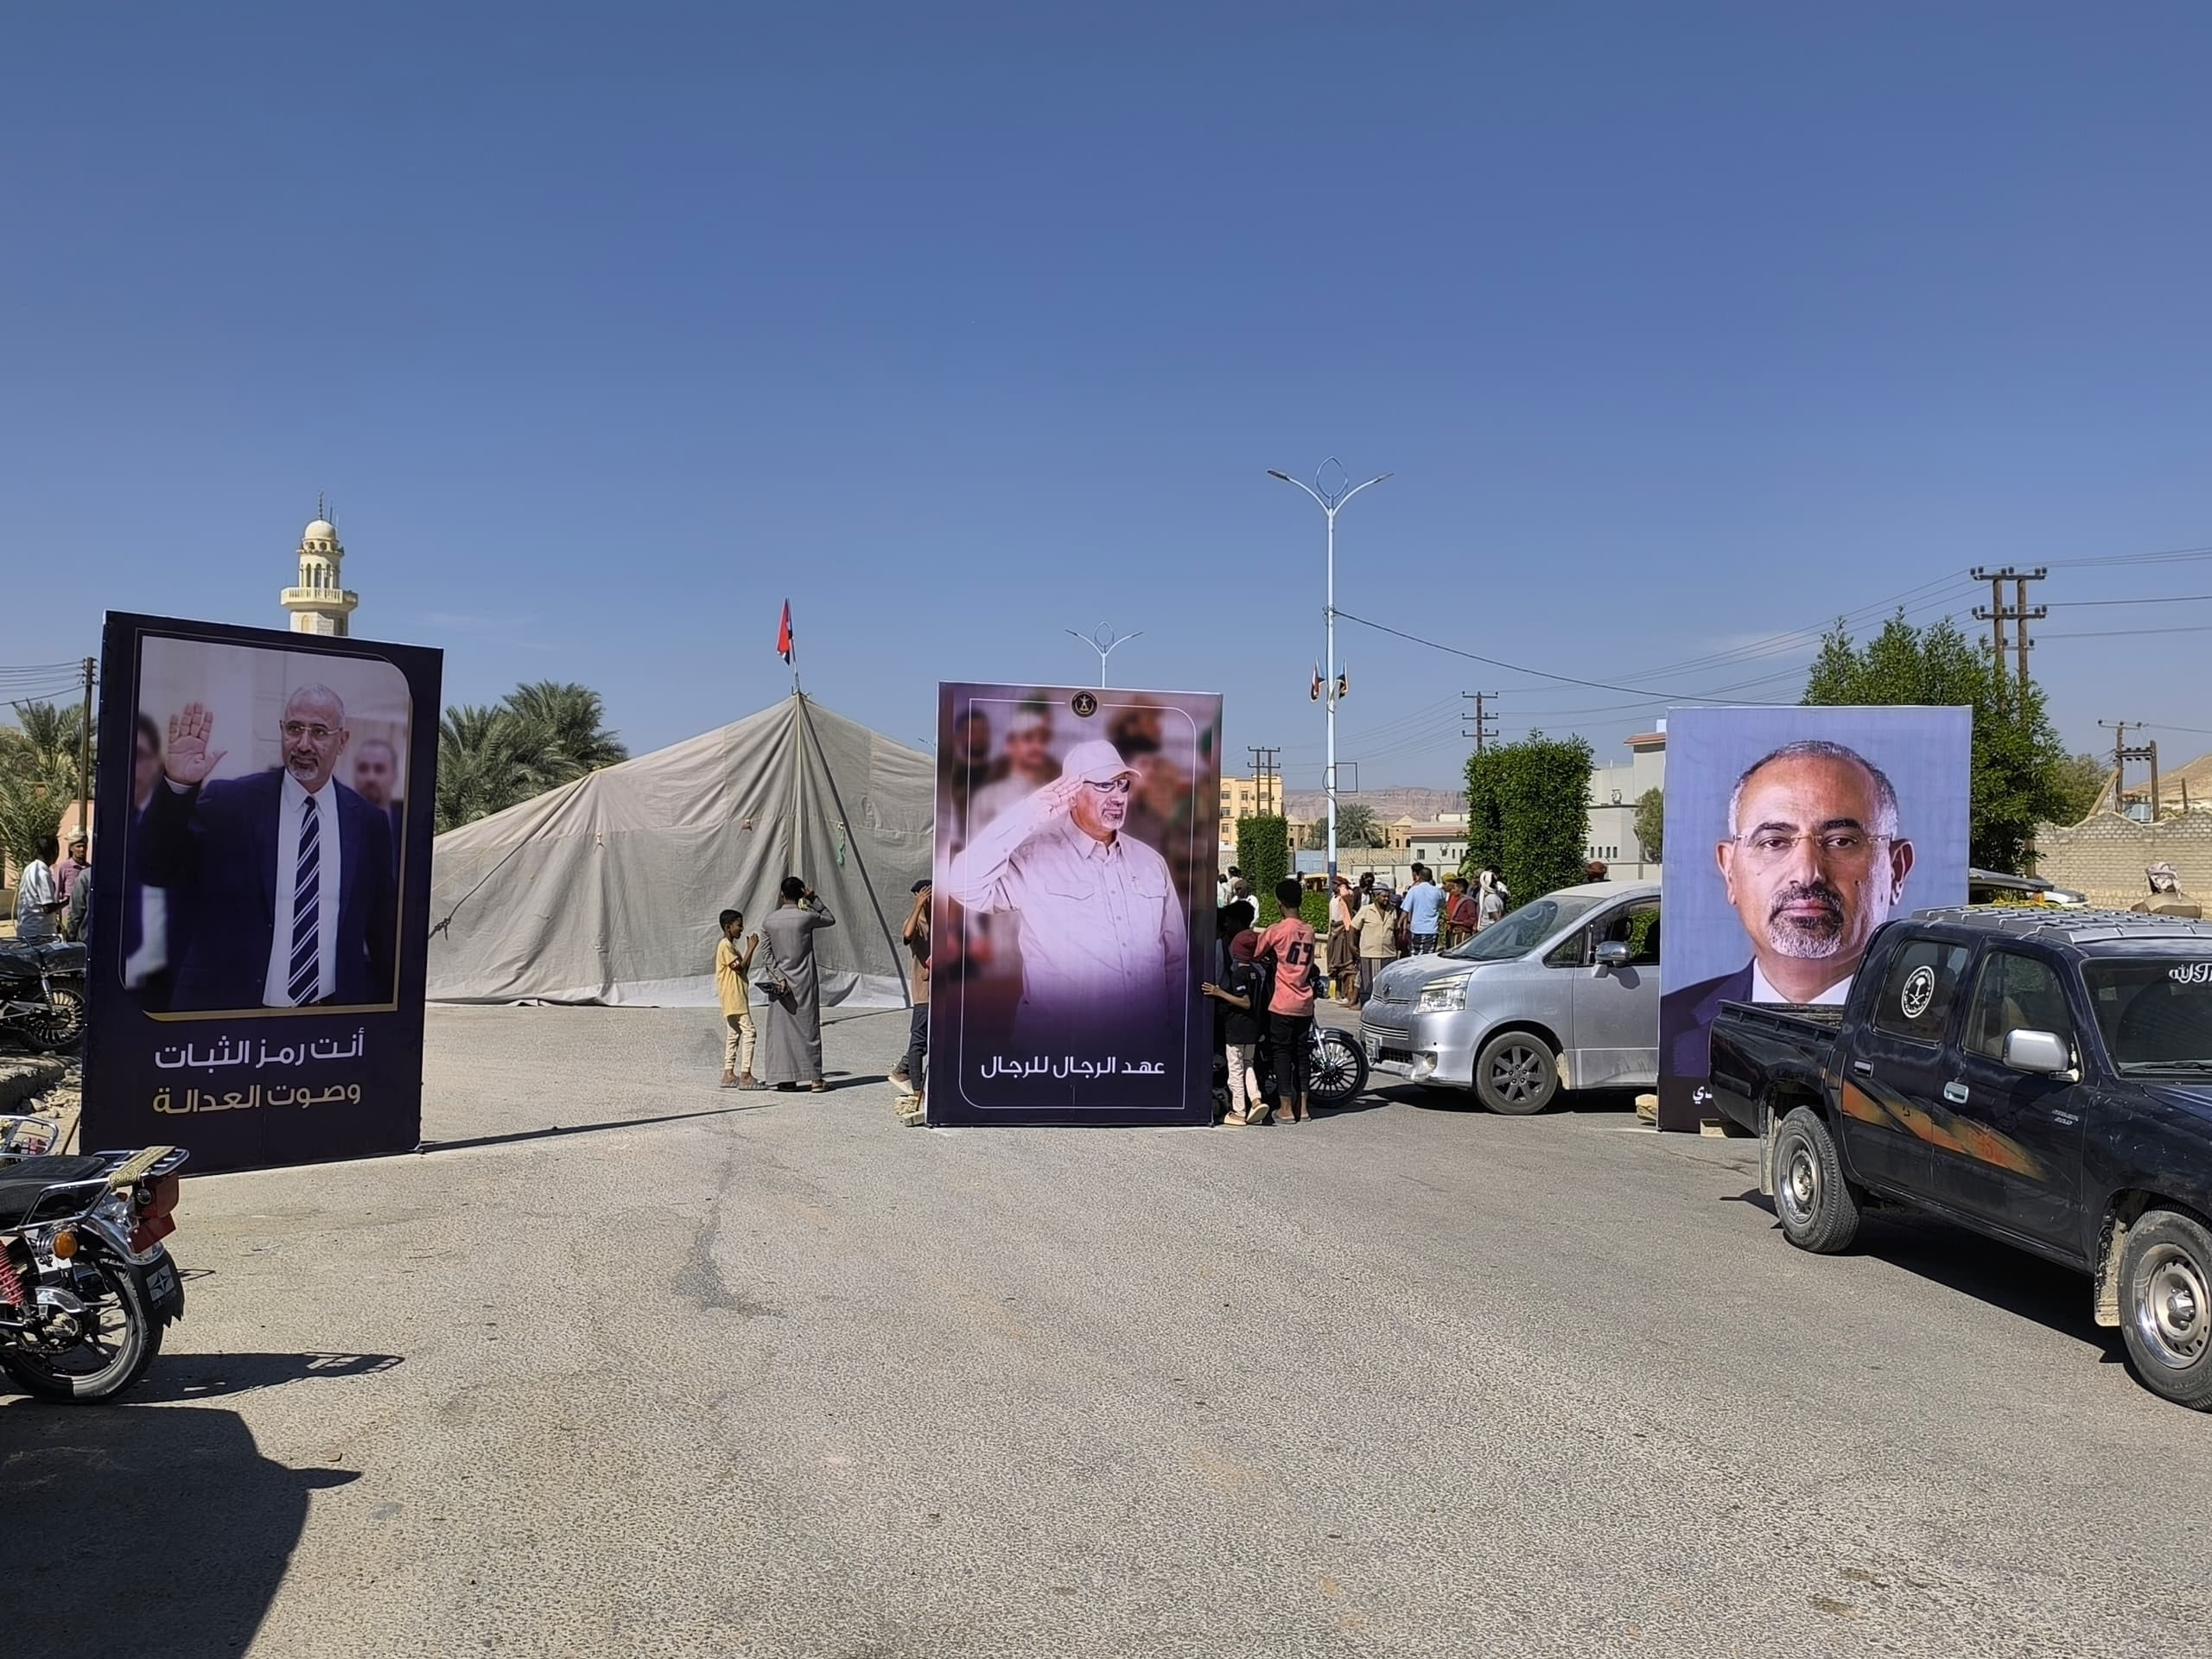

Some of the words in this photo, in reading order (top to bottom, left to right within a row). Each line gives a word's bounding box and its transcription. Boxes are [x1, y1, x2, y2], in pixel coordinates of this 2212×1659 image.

[1286, 941, 1313, 966] 69
[155, 1035, 251, 1074] الثبات
[255, 1039, 305, 1069] رمز
[310, 1027, 365, 1059] أنت
[981, 1055, 1049, 1079] للرجال
[1052, 1055, 1116, 1079] الرجال
[1121, 1061, 1166, 1074] عهد
[153, 1084, 261, 1114] العدالة
[267, 1084, 360, 1109] وصوت
